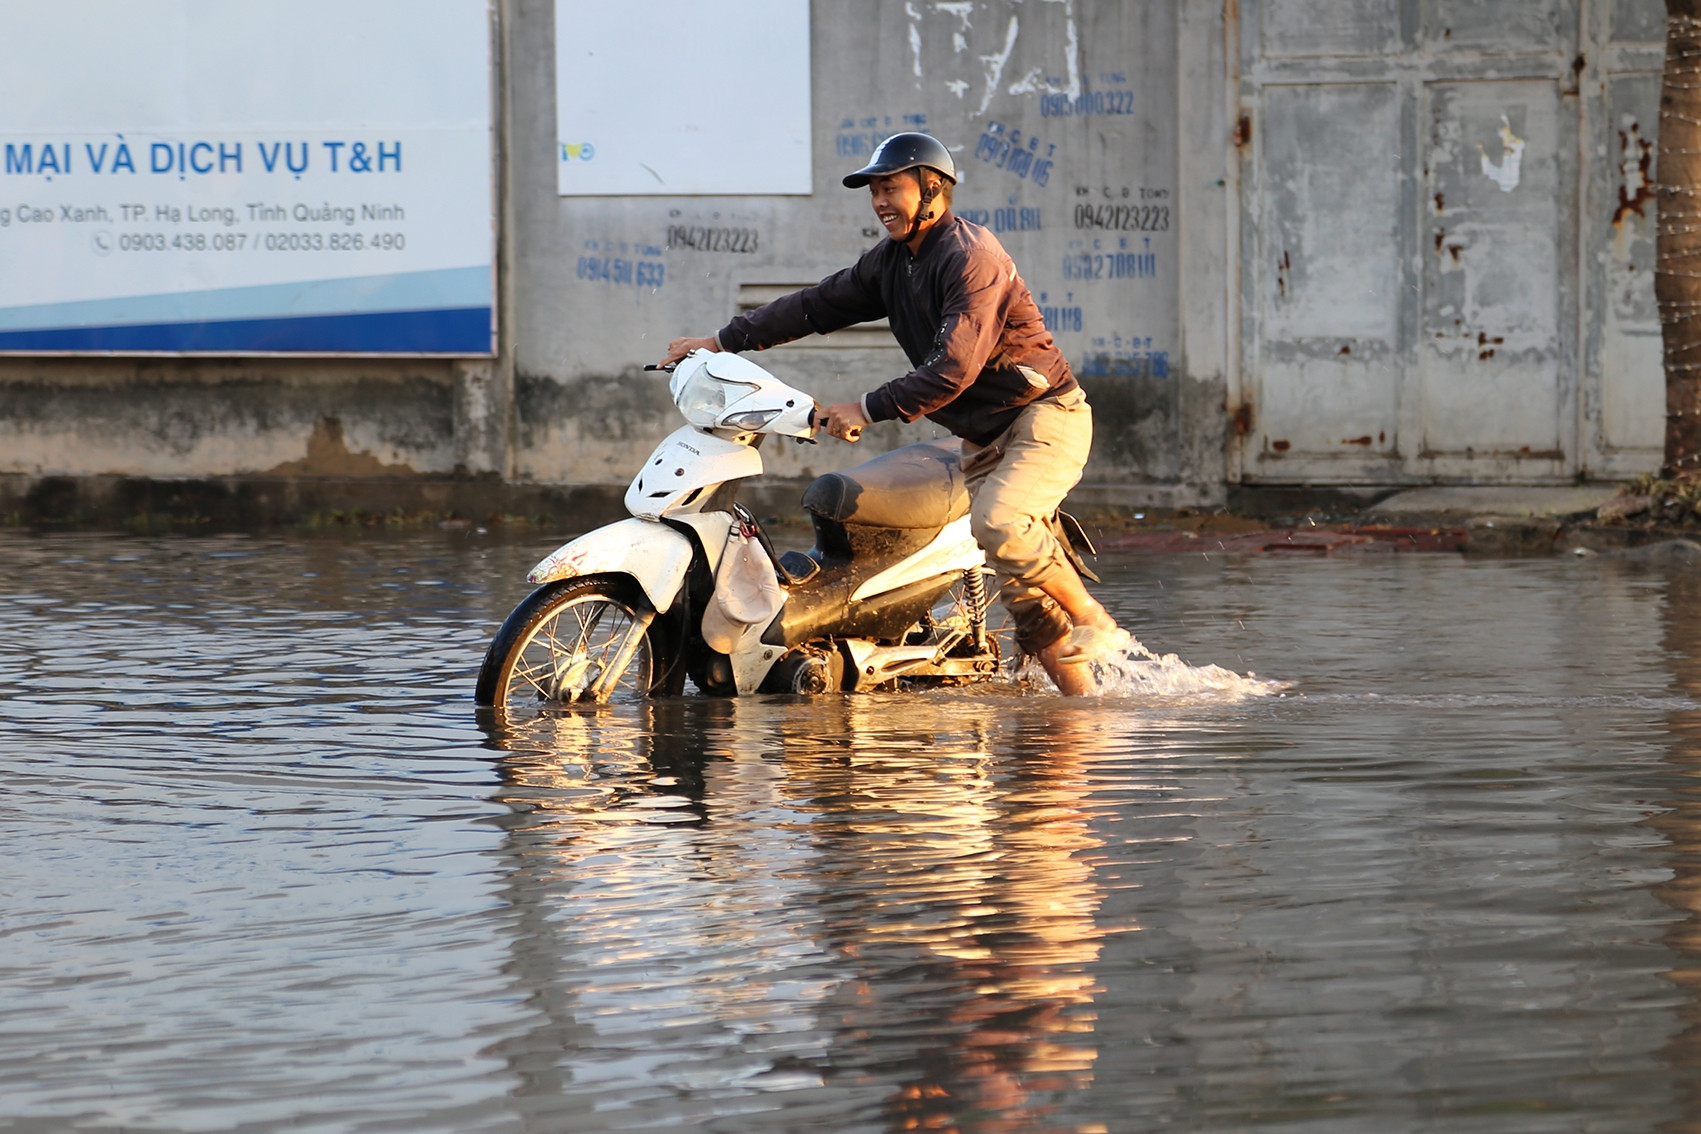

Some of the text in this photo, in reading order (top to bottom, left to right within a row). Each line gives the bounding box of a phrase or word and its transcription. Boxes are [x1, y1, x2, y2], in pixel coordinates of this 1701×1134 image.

[5, 132, 402, 182] MẠI VÀ DỊCH VỤ T&H
[17, 203, 55, 223] Cao
[60, 204, 114, 224] Xanh,
[119, 203, 149, 222] TP.
[187, 204, 240, 227] Long,
[293, 201, 355, 227] Quảng
[361, 202, 405, 222] Ninh
[1075, 203, 1170, 232] 0942123223
[119, 233, 248, 252] 0903.438.087
[265, 232, 405, 251] 02033.826.490
[667, 225, 759, 253] 0942123223
